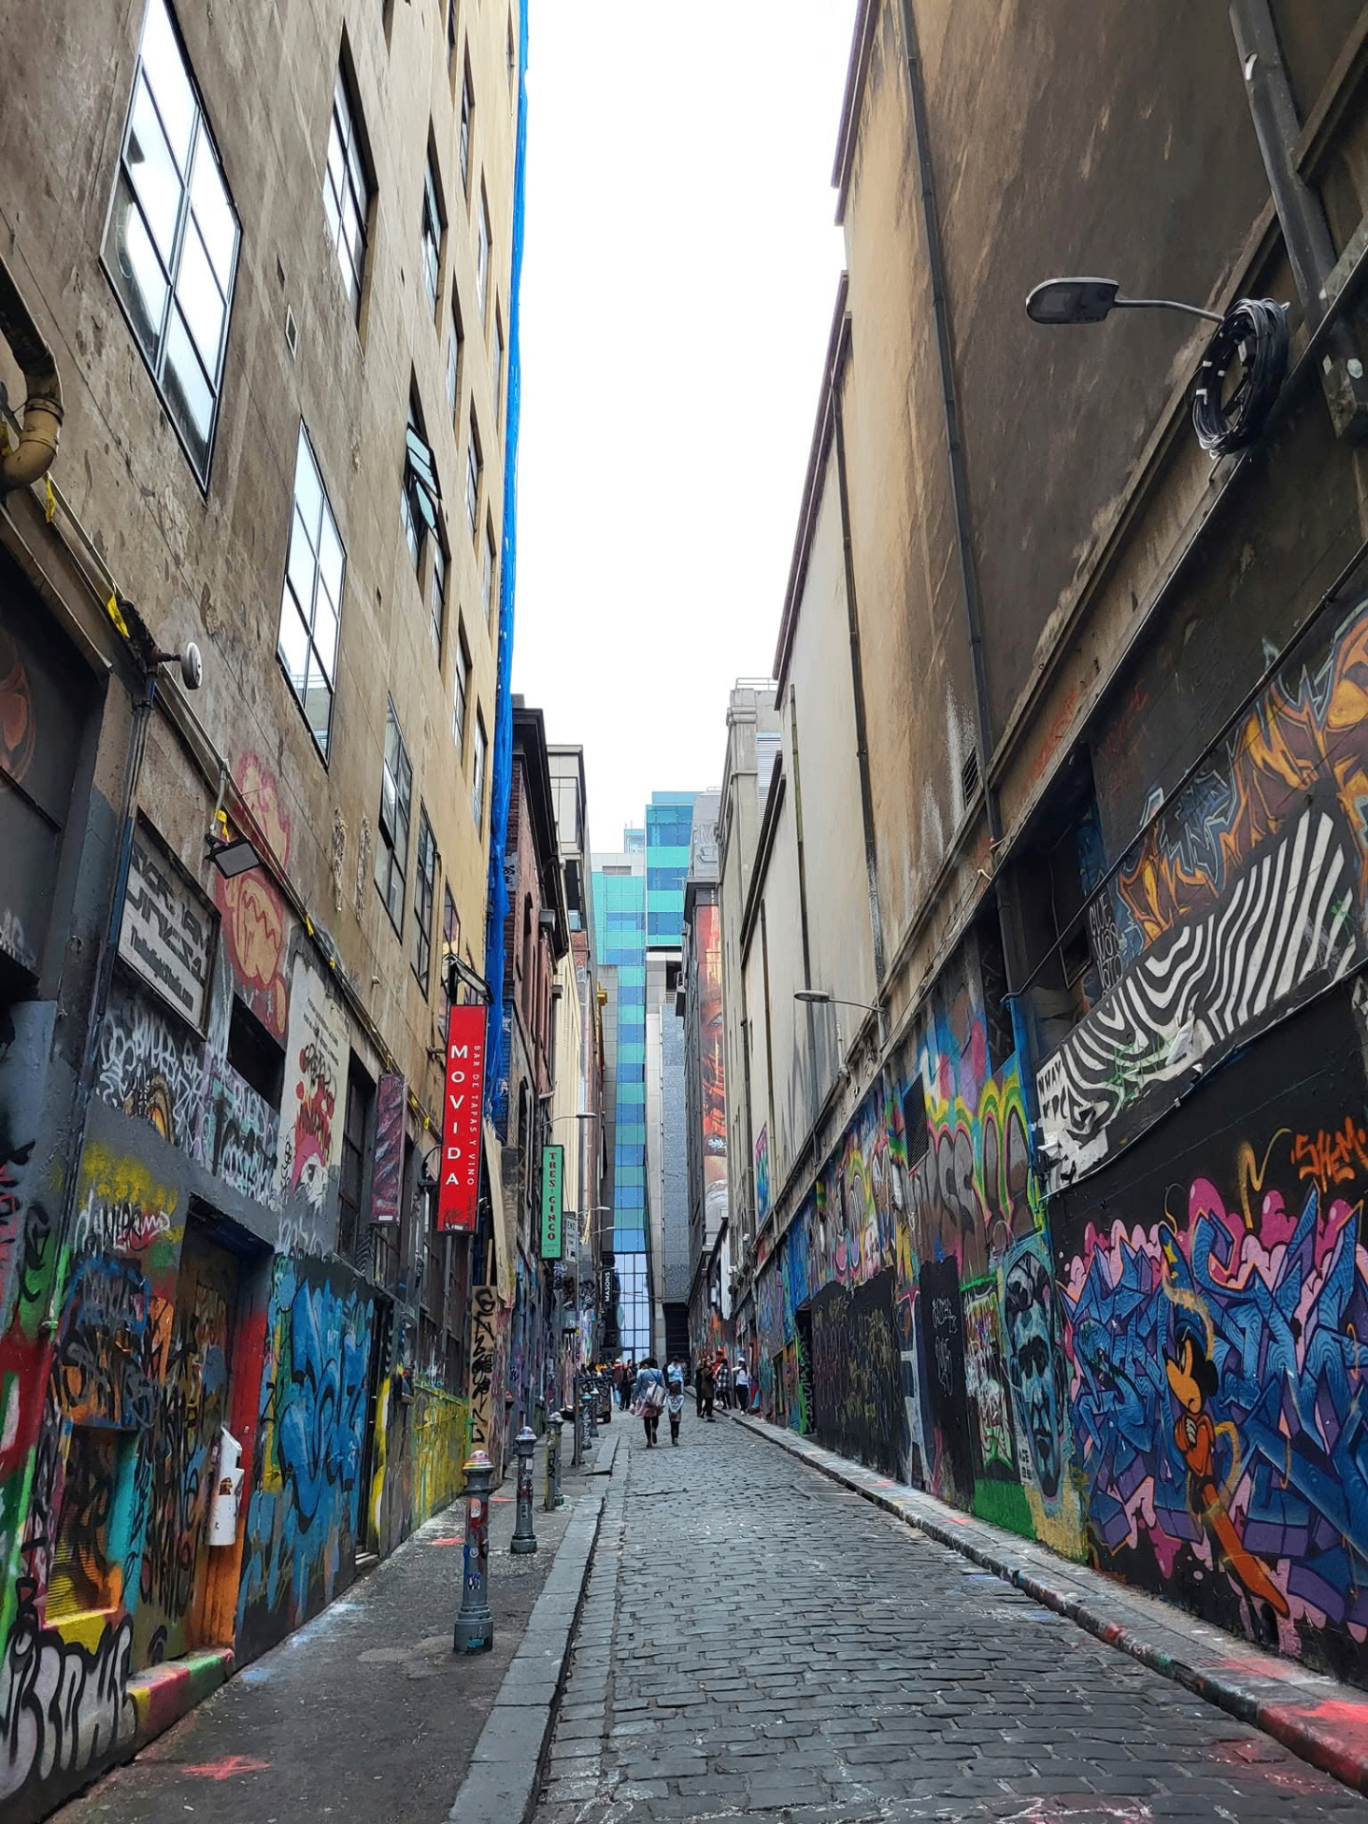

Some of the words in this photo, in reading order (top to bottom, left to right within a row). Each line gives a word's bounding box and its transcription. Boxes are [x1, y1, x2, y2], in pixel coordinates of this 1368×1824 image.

[473, 1045, 481, 1067] BAR
[472, 1073, 480, 1088] DE
[445, 1044, 468, 1185] MOVIDA
[470, 1095, 479, 1133] TAPAS
[467, 1153, 476, 1186] VINO
[548, 1152, 557, 1188] TRES
[547, 1195, 556, 1241] CINCO
